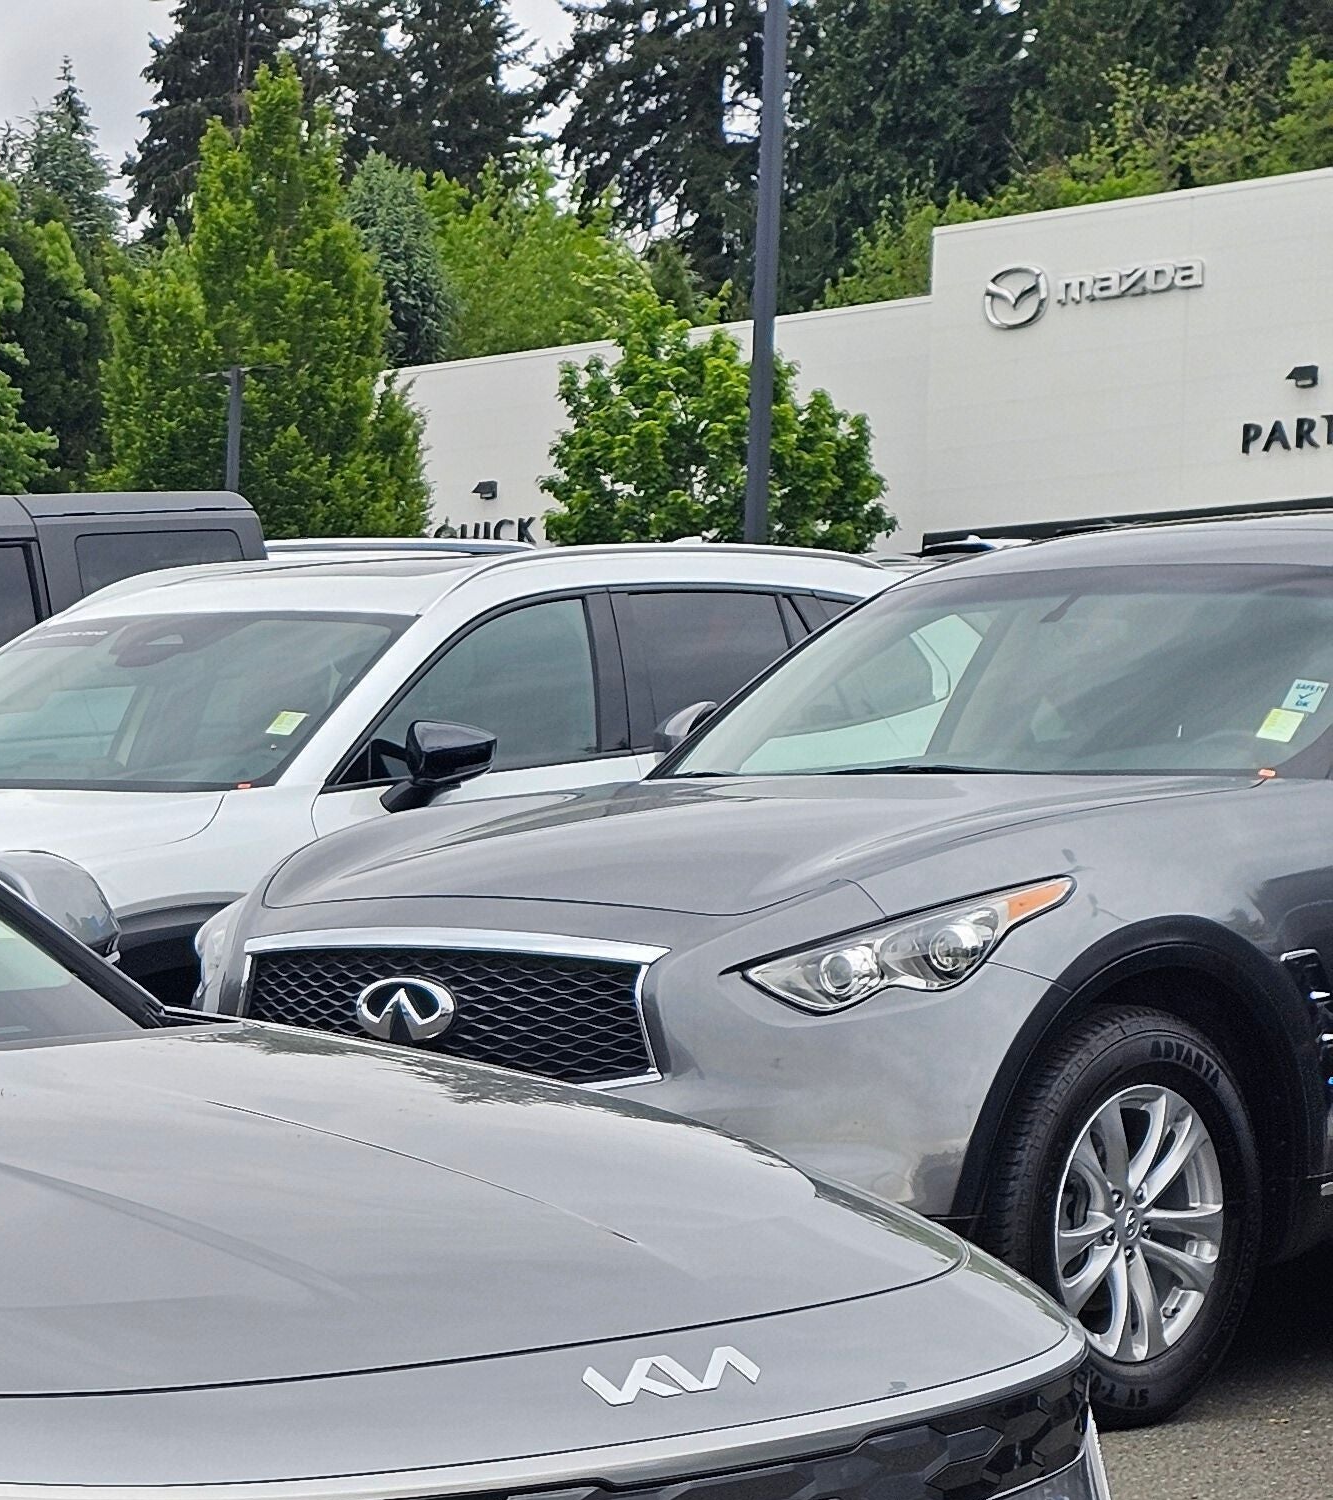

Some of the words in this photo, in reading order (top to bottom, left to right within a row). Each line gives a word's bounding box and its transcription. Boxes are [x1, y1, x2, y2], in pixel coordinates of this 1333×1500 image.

[1057, 260, 1204, 306] mazda
[1149, 1039, 1221, 1089] ADVANTA
[581, 1345, 761, 1407] KIA
